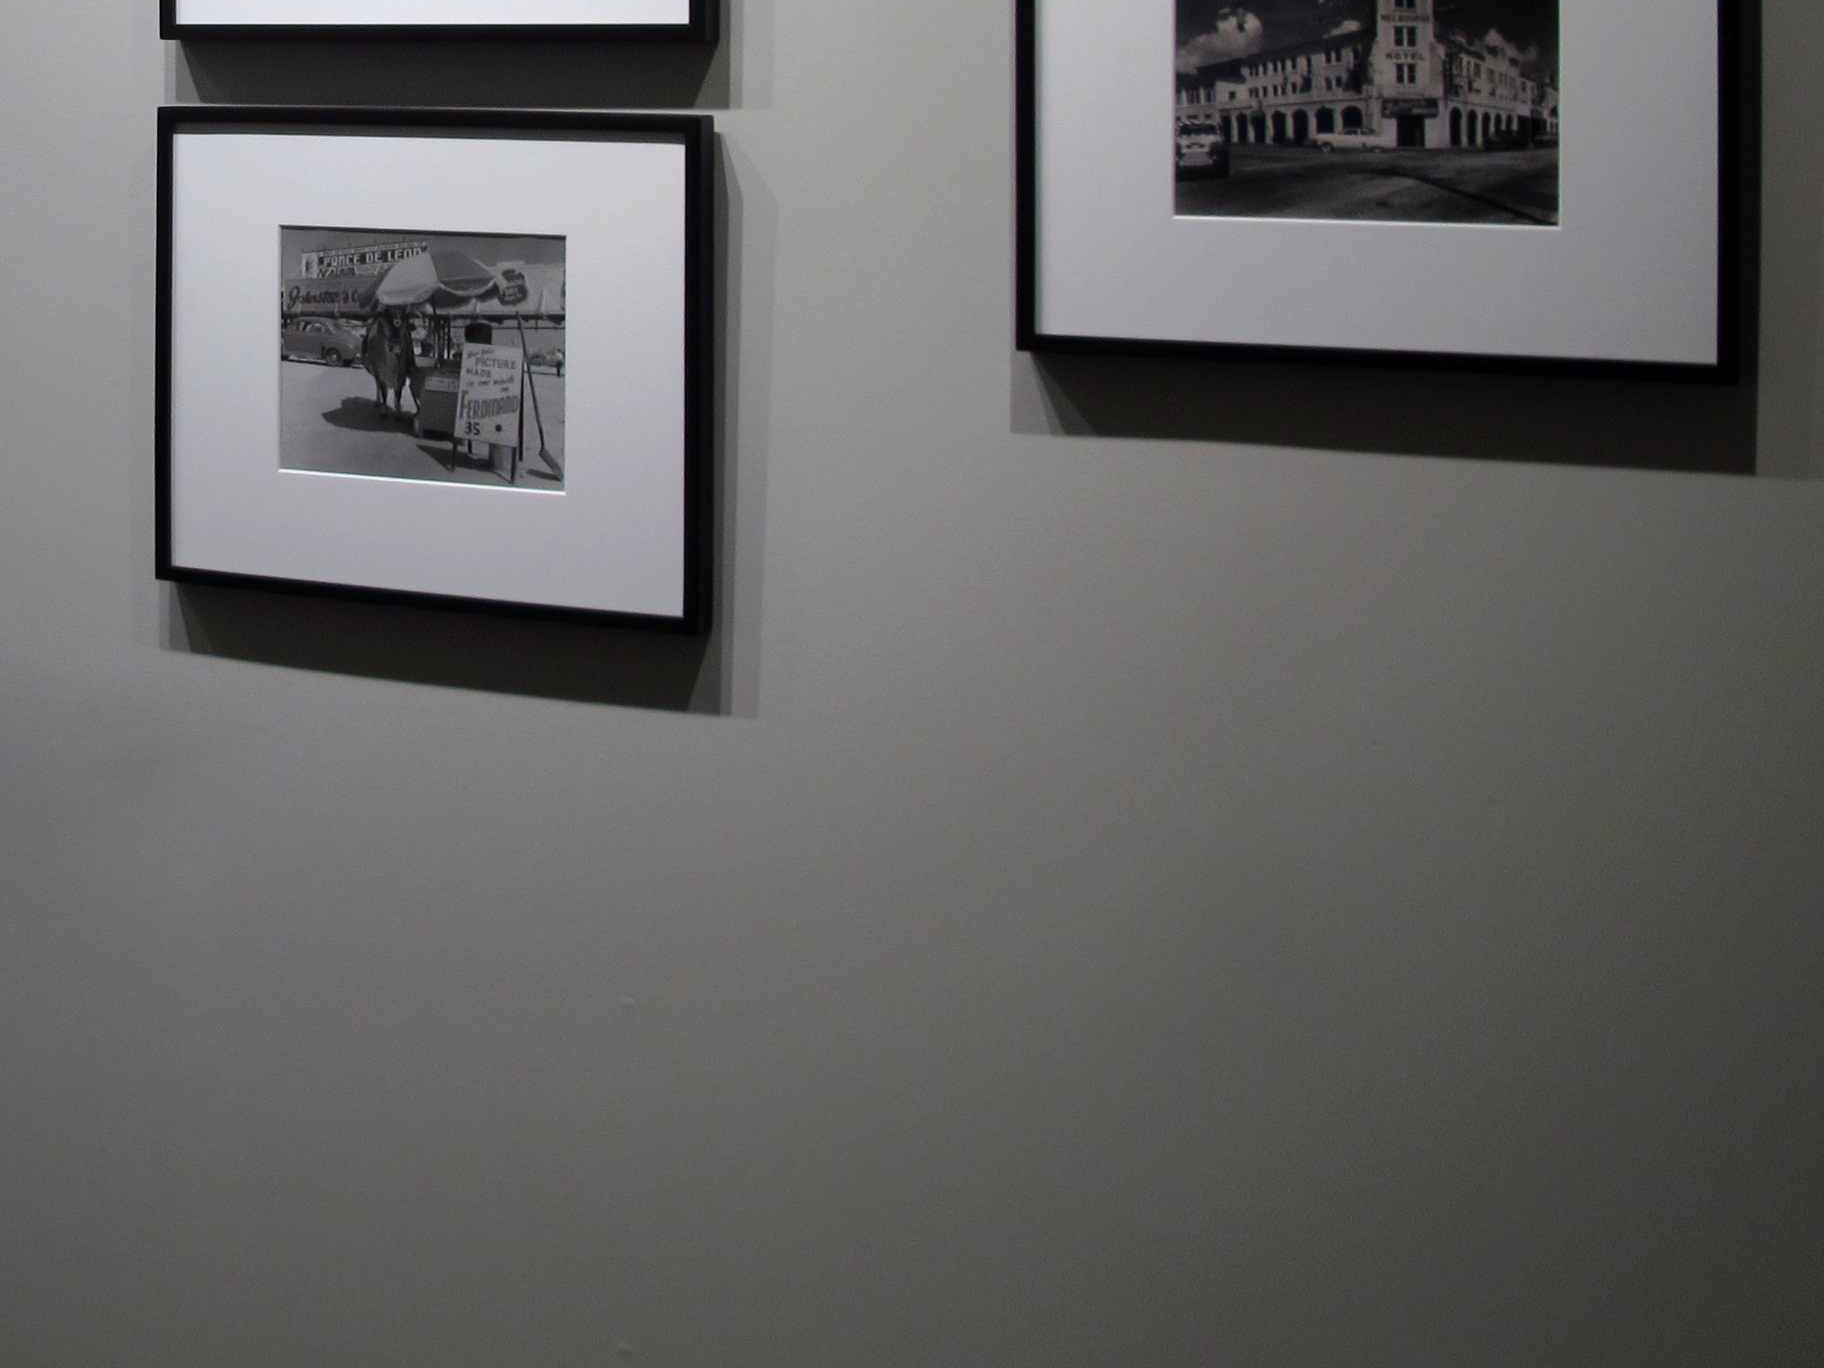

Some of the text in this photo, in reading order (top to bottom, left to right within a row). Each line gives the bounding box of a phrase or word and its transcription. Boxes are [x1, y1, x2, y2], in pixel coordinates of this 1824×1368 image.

[1385, 53, 1425, 61] HOTEL
[366, 251, 383, 264] DE
[475, 357, 517, 370] PICTURE
[464, 421, 480, 435] 35
